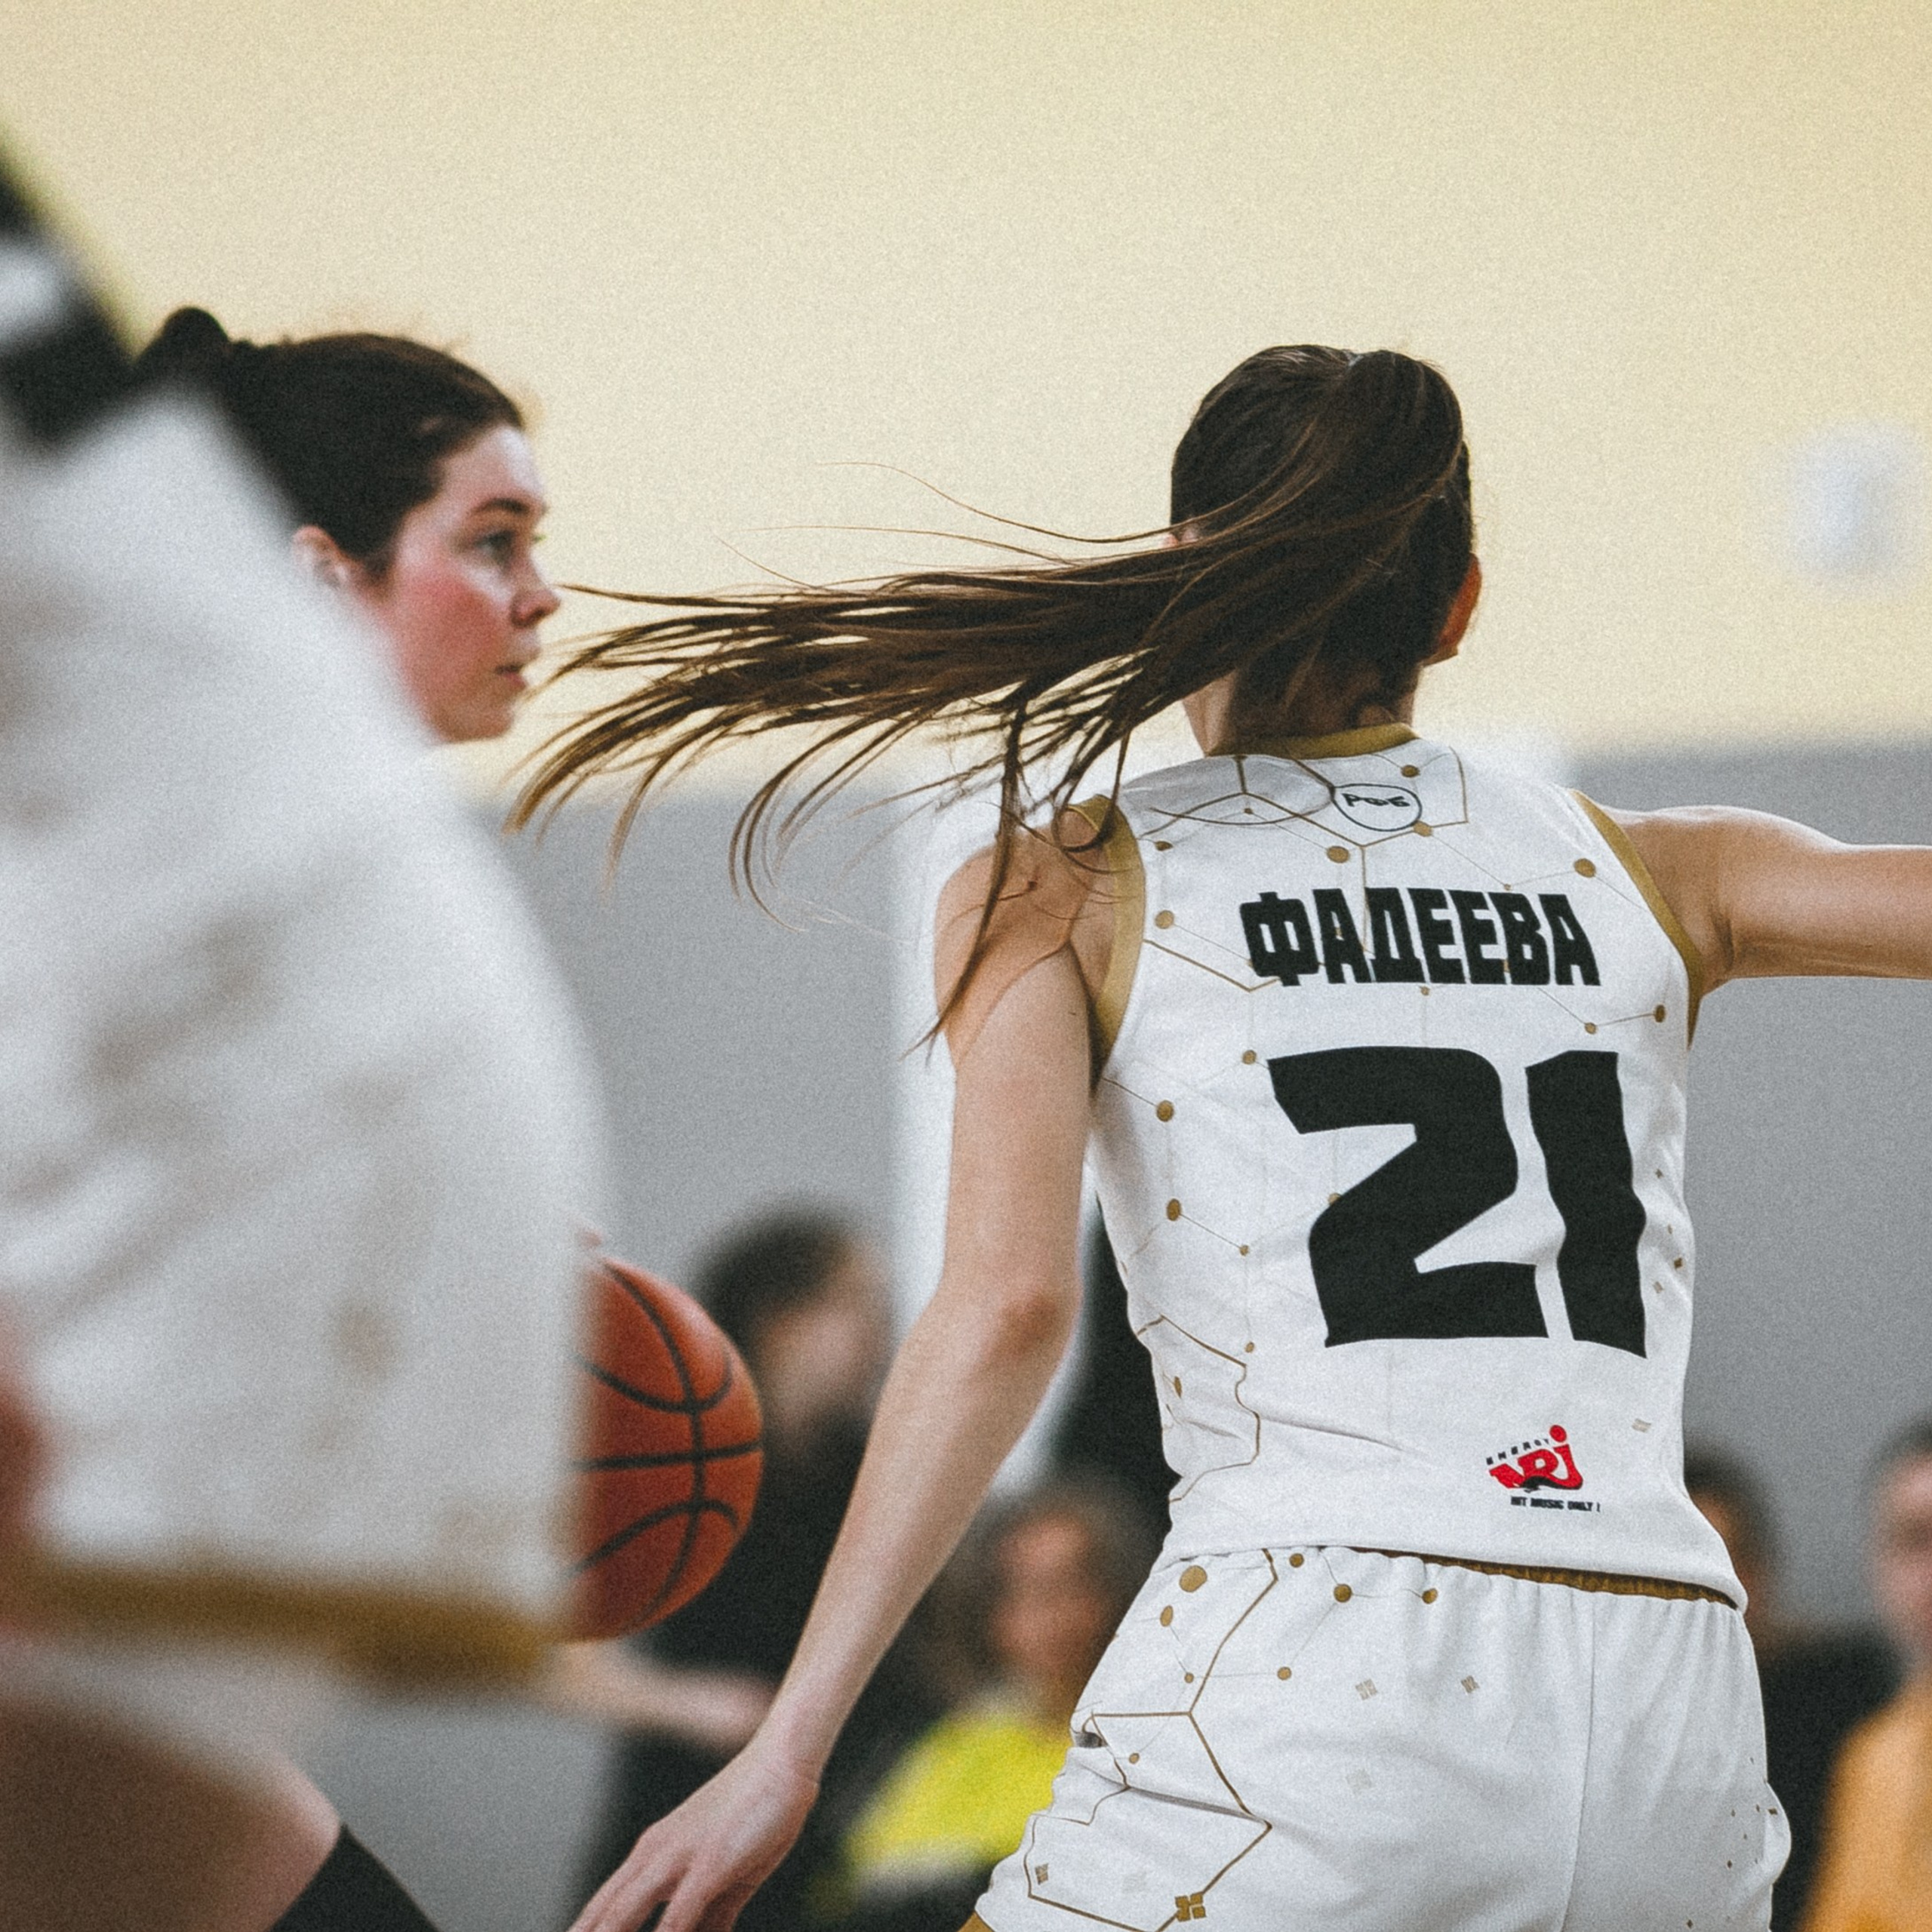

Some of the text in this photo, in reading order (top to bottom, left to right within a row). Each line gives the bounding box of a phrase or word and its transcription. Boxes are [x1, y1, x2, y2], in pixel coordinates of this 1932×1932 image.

[1240, 888, 1600, 986] ФАДЕЕВА
[1268, 1047, 1646, 1357] 21
[1531, 1497, 1564, 1510] MUSIC
